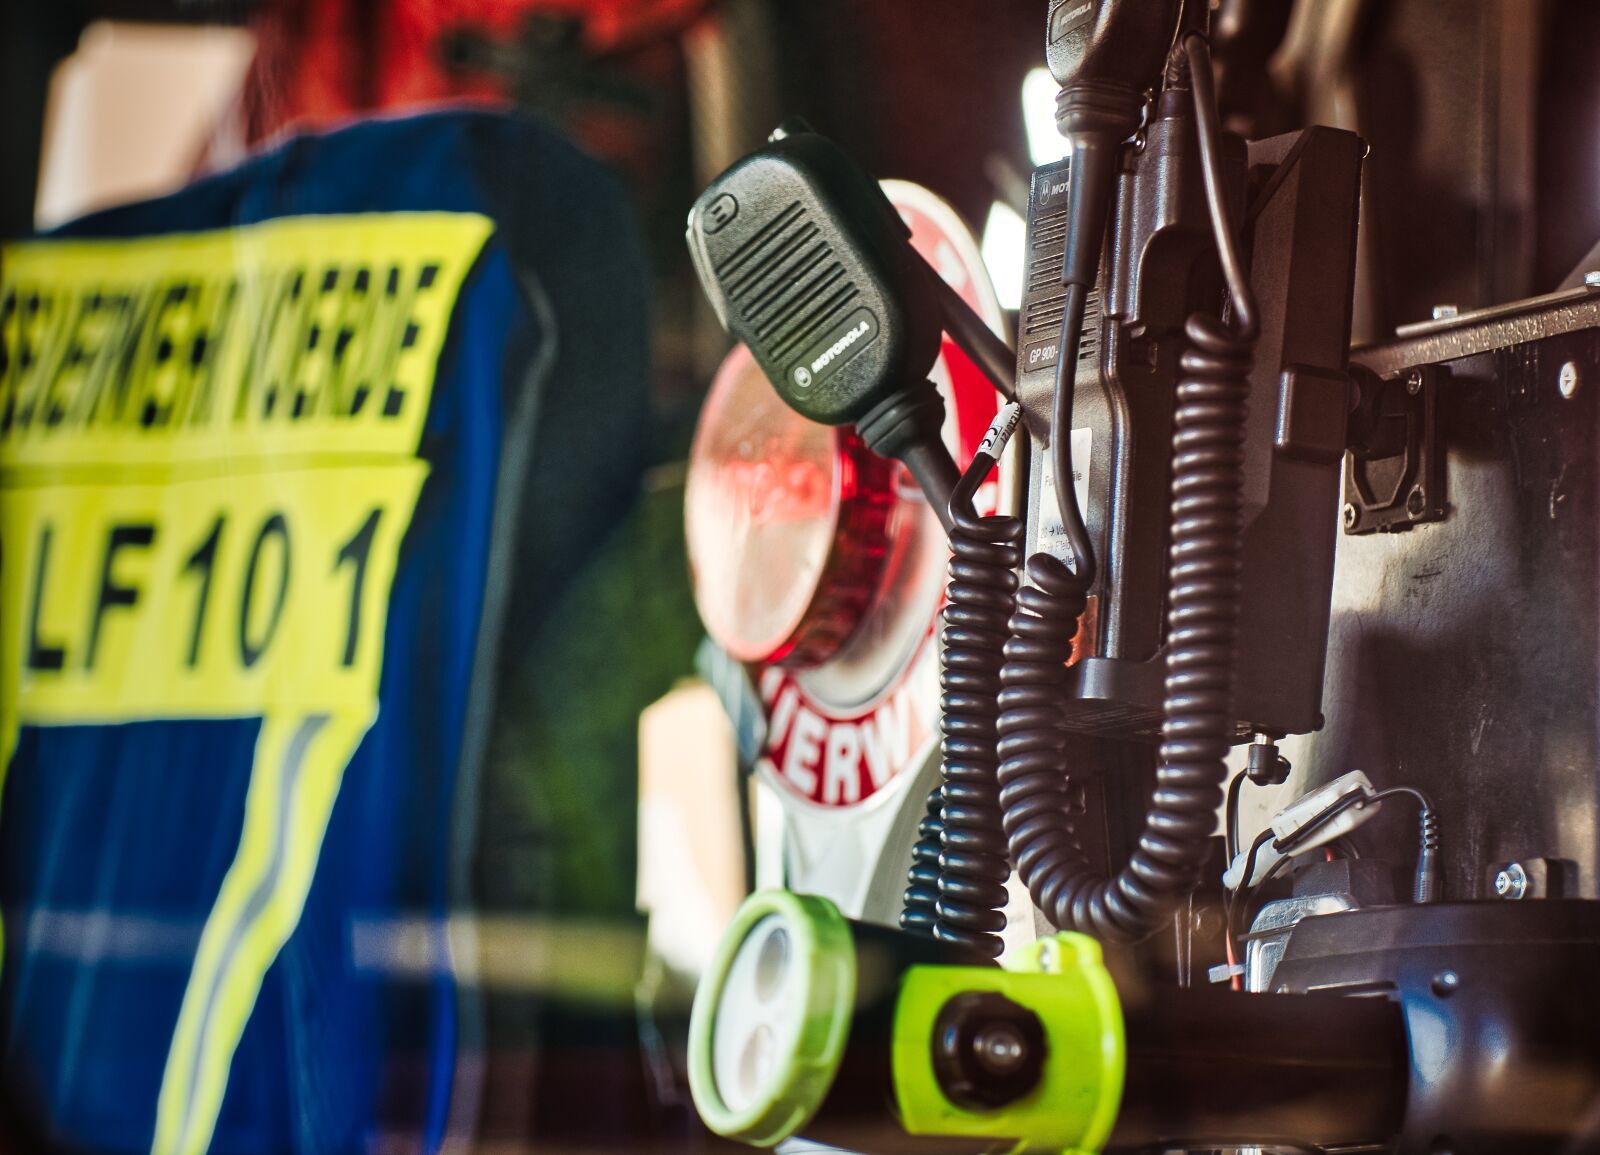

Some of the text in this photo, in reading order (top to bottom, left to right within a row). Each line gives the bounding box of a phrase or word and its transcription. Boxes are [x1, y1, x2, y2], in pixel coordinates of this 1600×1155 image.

[1060, 2, 1092, 26] MOTOROLA
[811, 320, 870, 374] MOTOROLA
[1029, 348, 1042, 364] GP
[27, 506, 385, 671] LF 10 1
